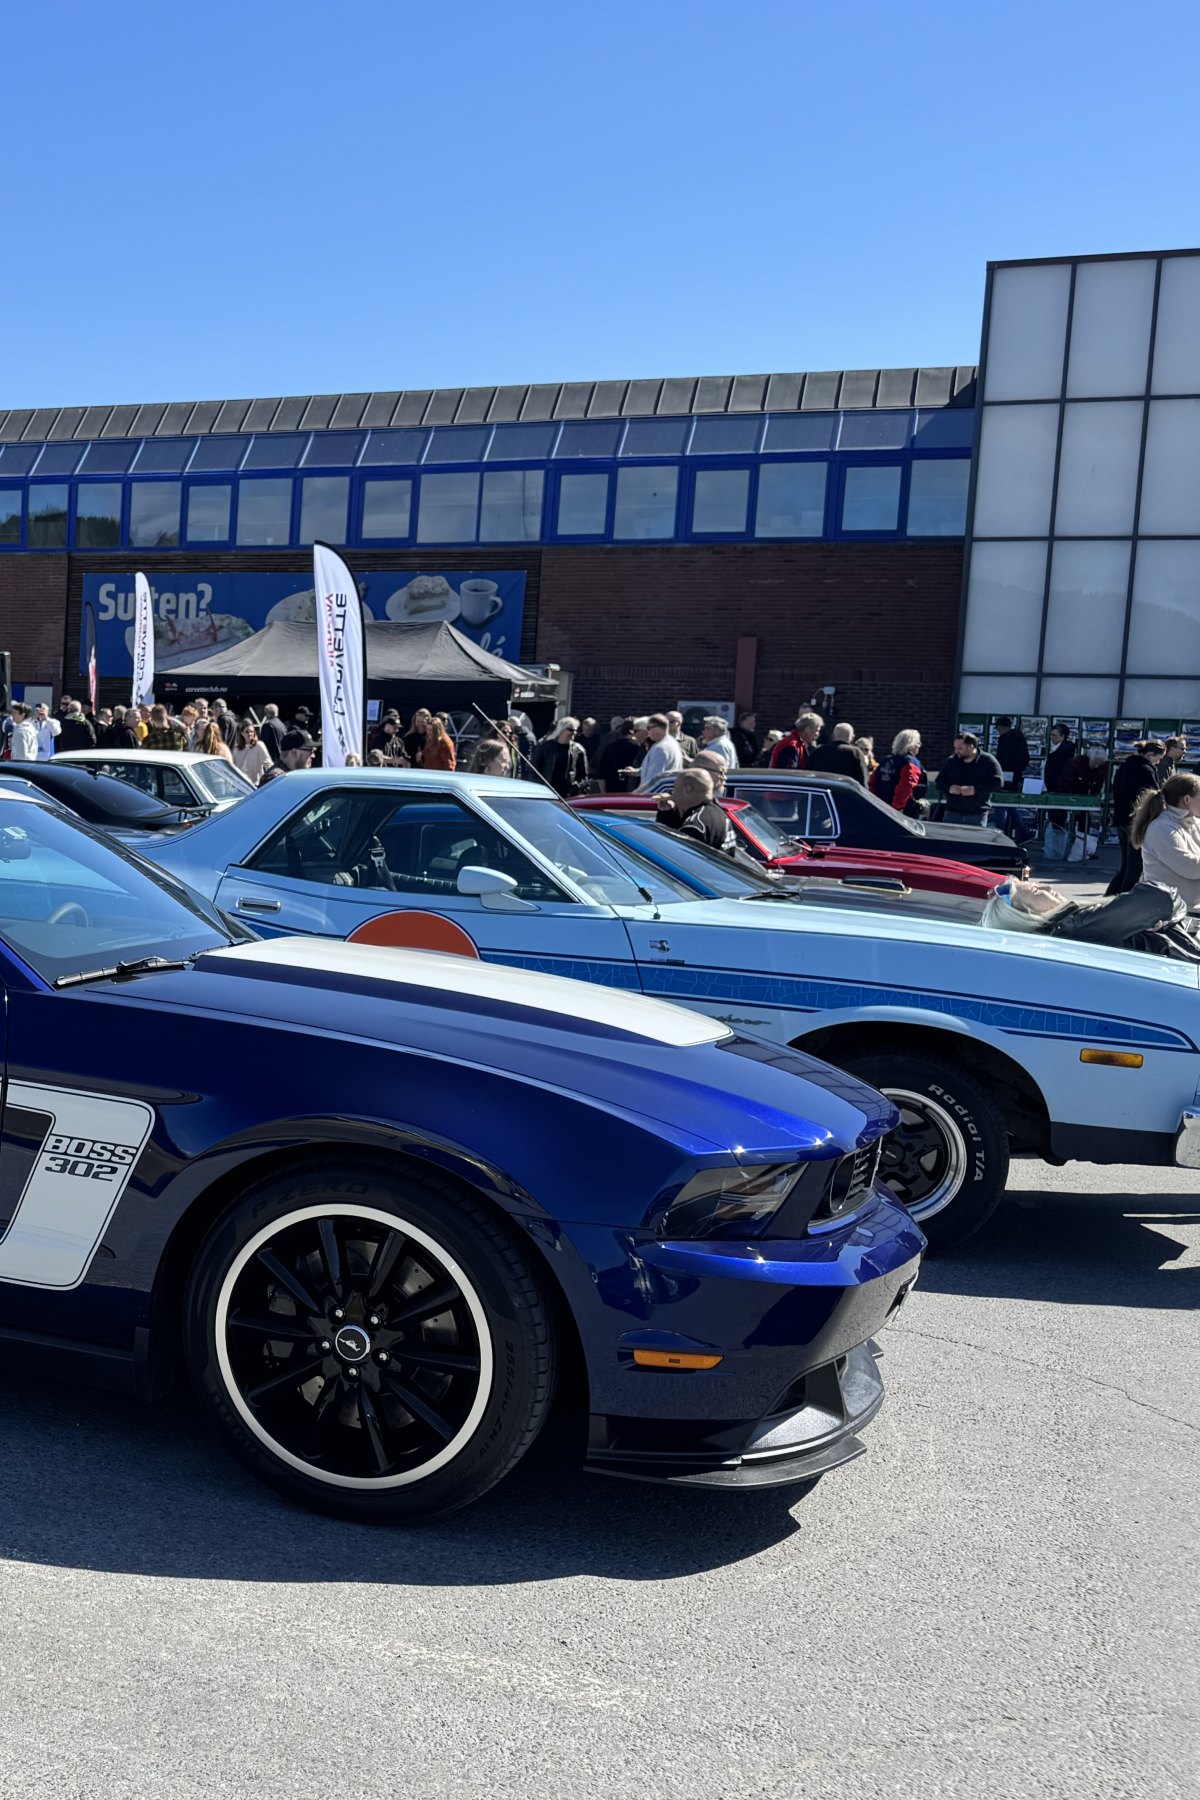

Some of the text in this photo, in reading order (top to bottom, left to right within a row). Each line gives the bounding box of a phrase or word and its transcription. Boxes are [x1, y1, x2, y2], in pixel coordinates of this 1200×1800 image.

[98, 583, 213, 621] Suten?
[43, 1134, 137, 1164] BOSS
[928, 1084, 985, 1181] Radial T/A
[45, 1156, 118, 1182] 302
